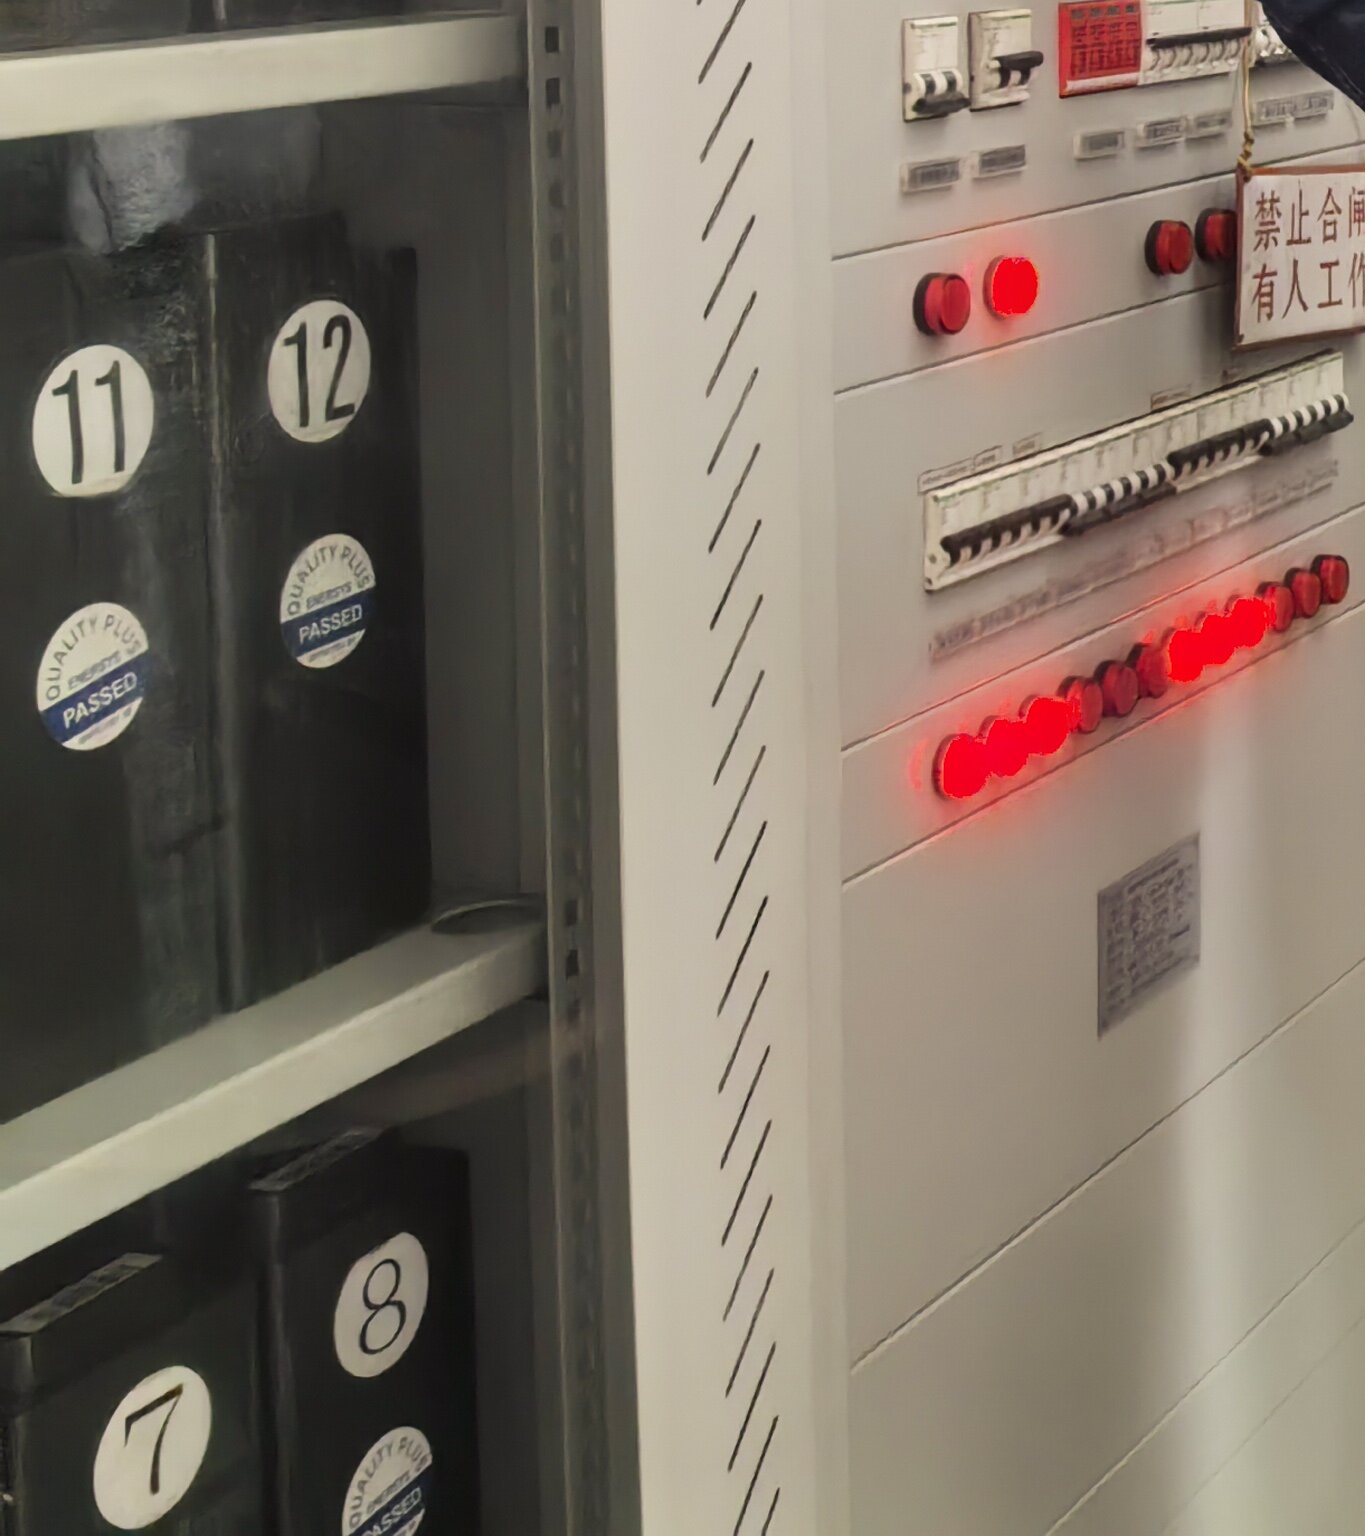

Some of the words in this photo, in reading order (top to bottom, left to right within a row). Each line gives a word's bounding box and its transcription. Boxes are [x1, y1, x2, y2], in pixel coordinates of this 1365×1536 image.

[283, 314, 355, 427] 12
[52, 360, 125, 484] 11
[286, 545, 339, 615] QUALITY
[340, 545, 372, 590] PLUS
[299, 604, 362, 644] PASSED
[46, 615, 98, 702] QUALITY
[103, 614, 143, 654] PLUS
[63, 672, 137, 728] PASSED
[359, 1258, 407, 1355] 8
[124, 1383, 184, 1495] 7
[349, 1440, 394, 1528] QUALITY
